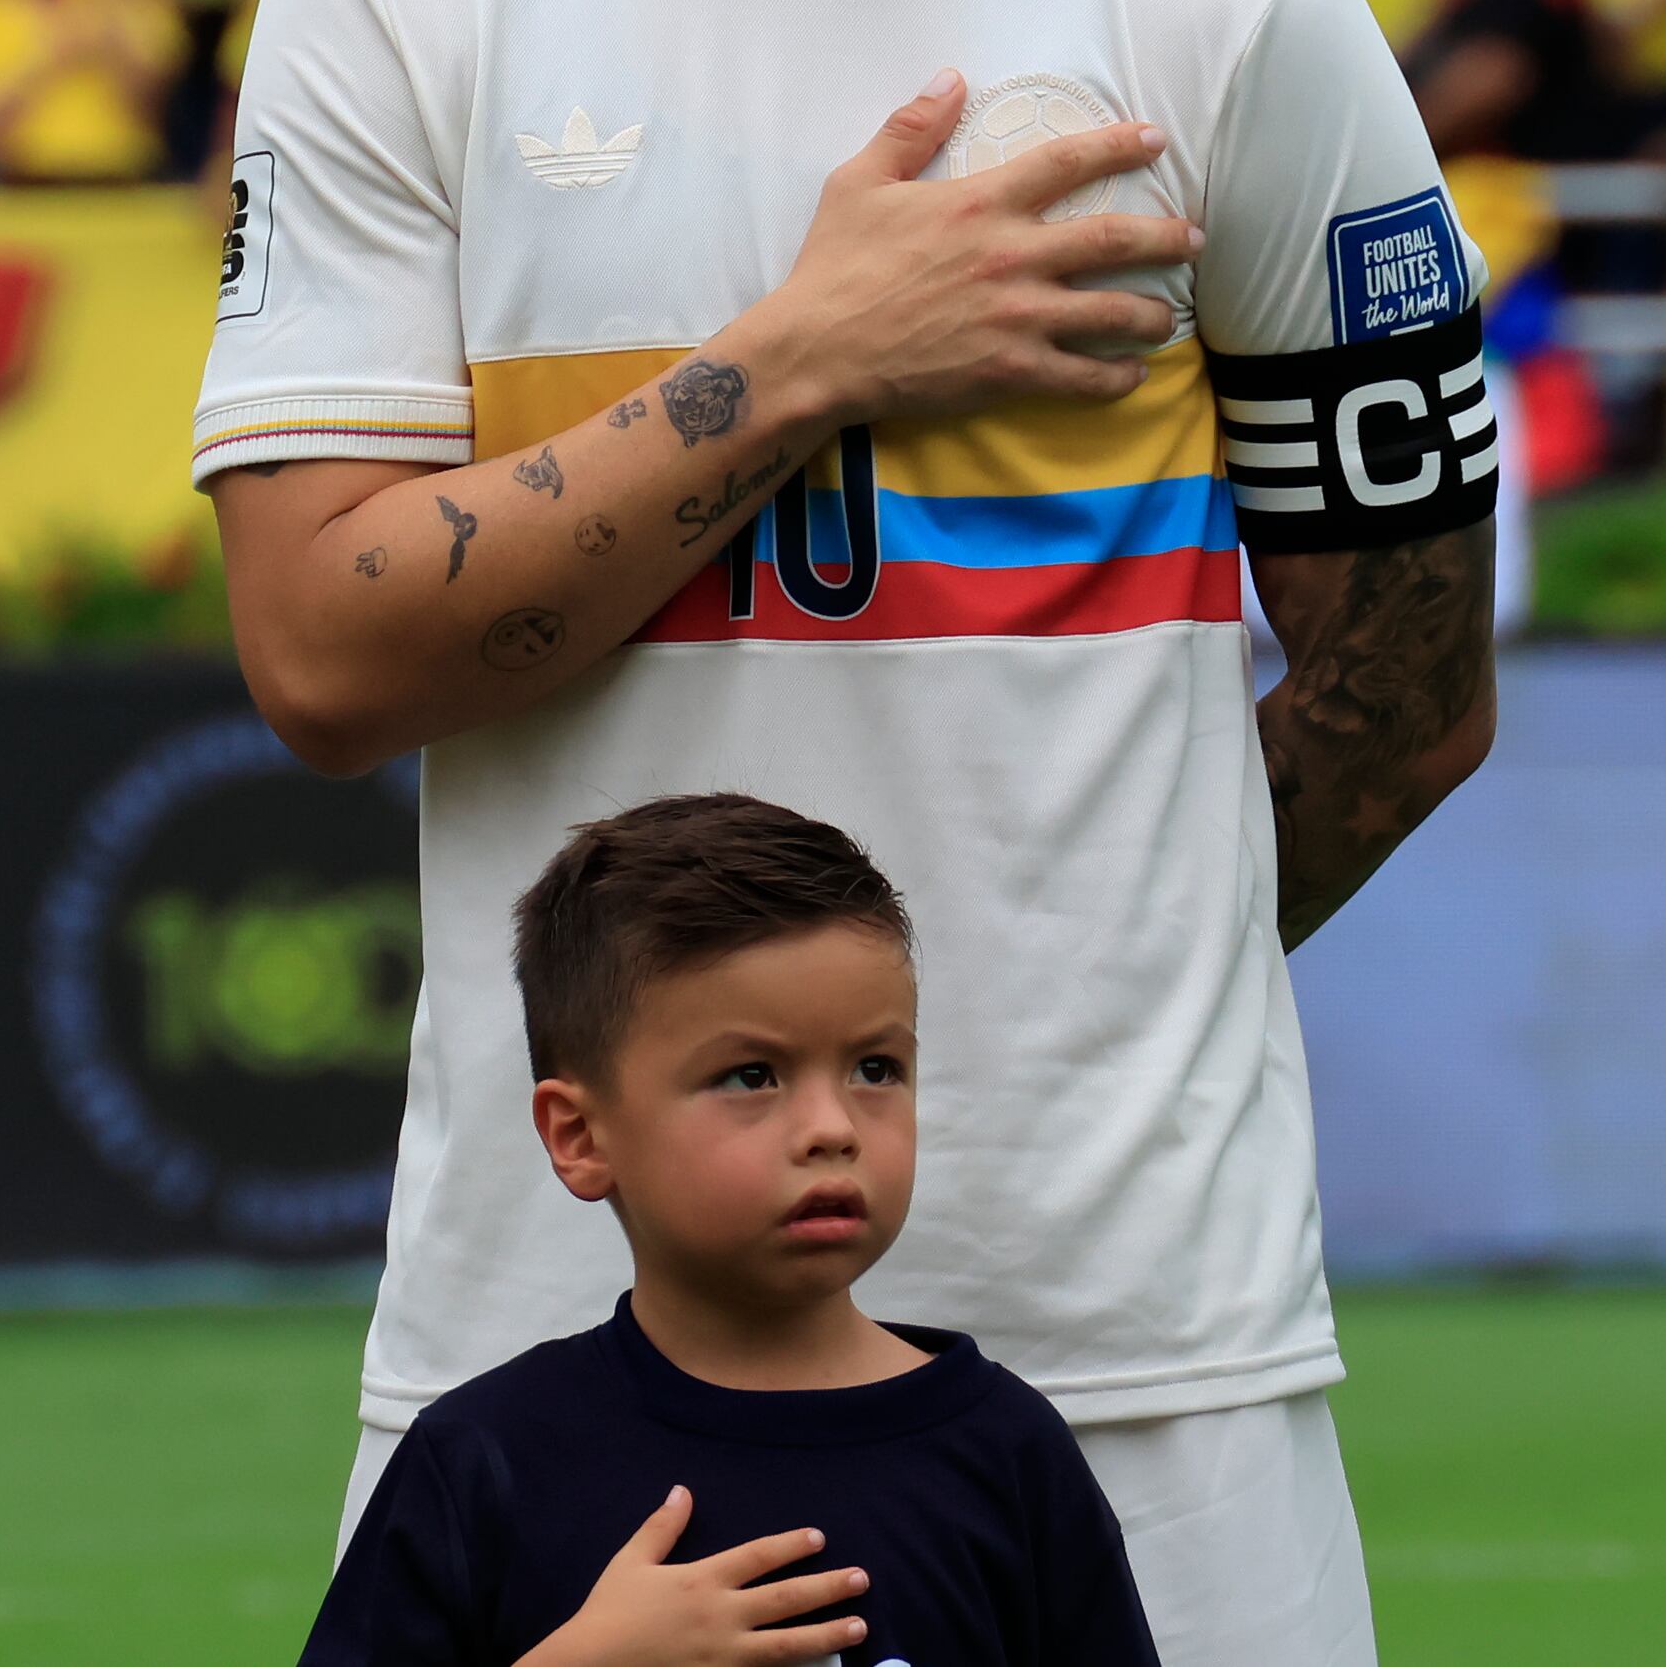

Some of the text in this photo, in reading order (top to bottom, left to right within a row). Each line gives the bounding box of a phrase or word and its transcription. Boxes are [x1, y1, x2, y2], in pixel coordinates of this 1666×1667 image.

[1363, 225, 1437, 266] FOOTBALL
[1365, 250, 1442, 298] UNITES
[1362, 281, 1451, 330] the World
[1335, 379, 1442, 507] C
